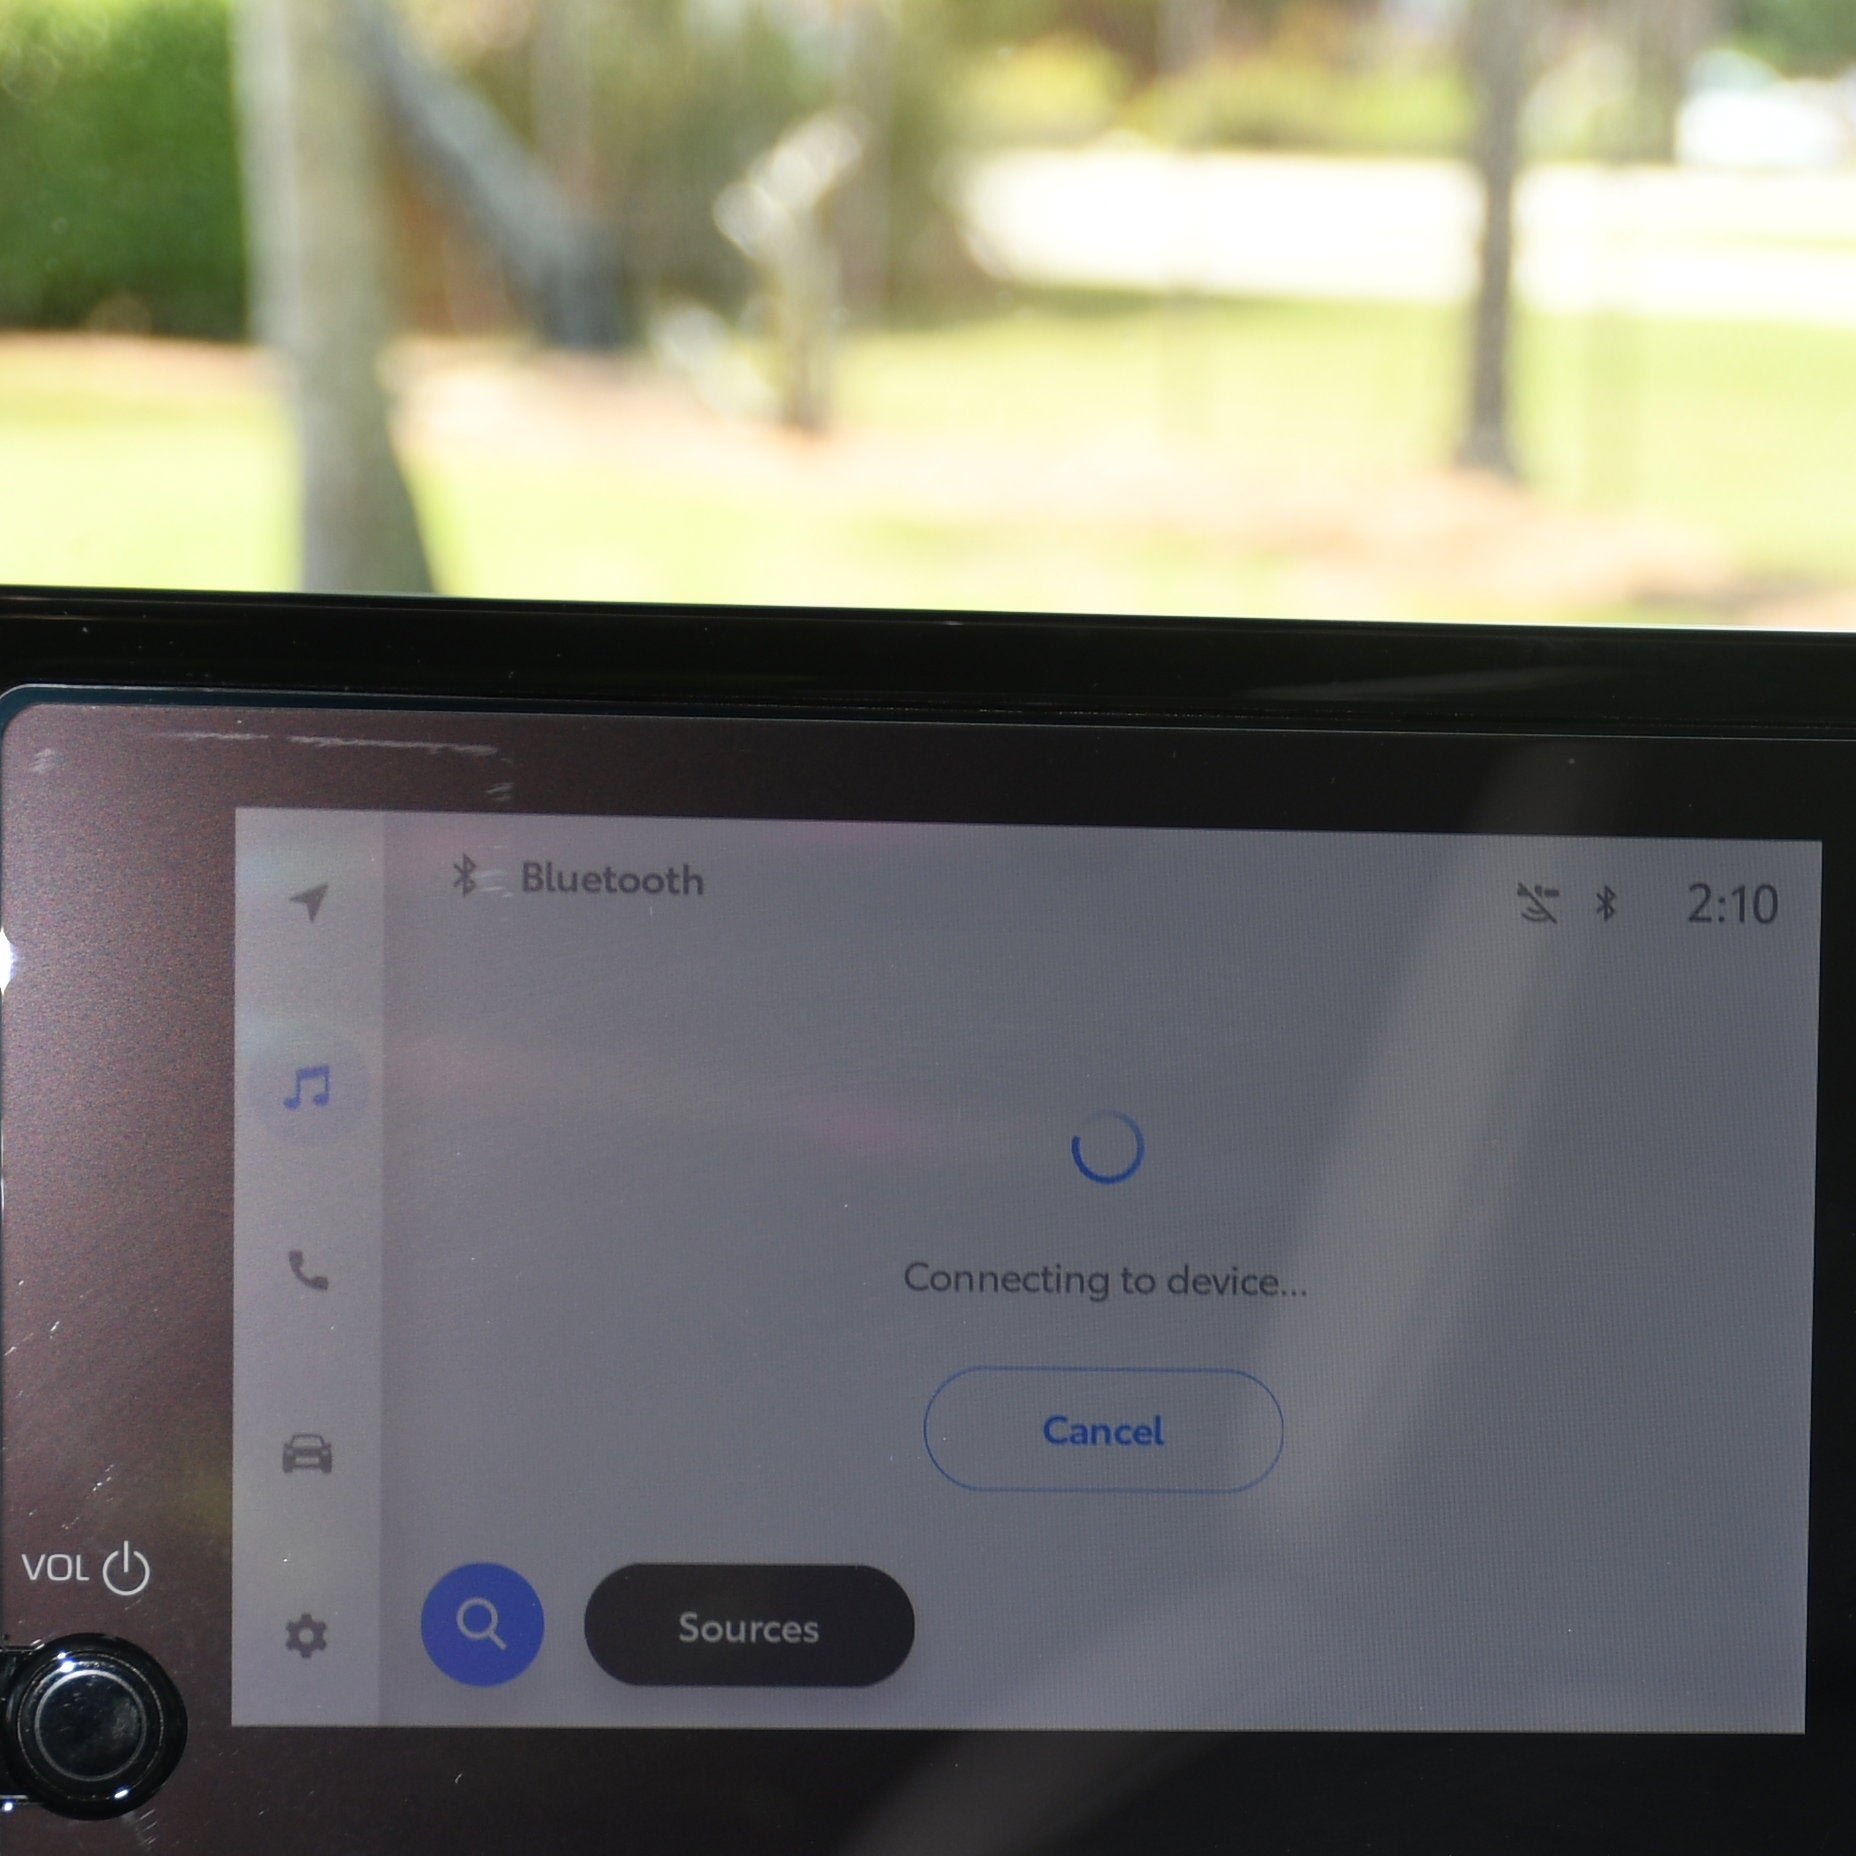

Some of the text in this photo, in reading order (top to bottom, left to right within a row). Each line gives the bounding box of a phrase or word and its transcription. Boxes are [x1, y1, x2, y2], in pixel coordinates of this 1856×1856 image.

[521, 863, 705, 898] Bluetooth
[1687, 884, 1779, 925] 2:10
[904, 1263, 1308, 1302] Connecting to device...
[1042, 1414, 1165, 1447] Cancel
[21, 1553, 90, 1582] VOL
[679, 1613, 819, 1646] Sources
